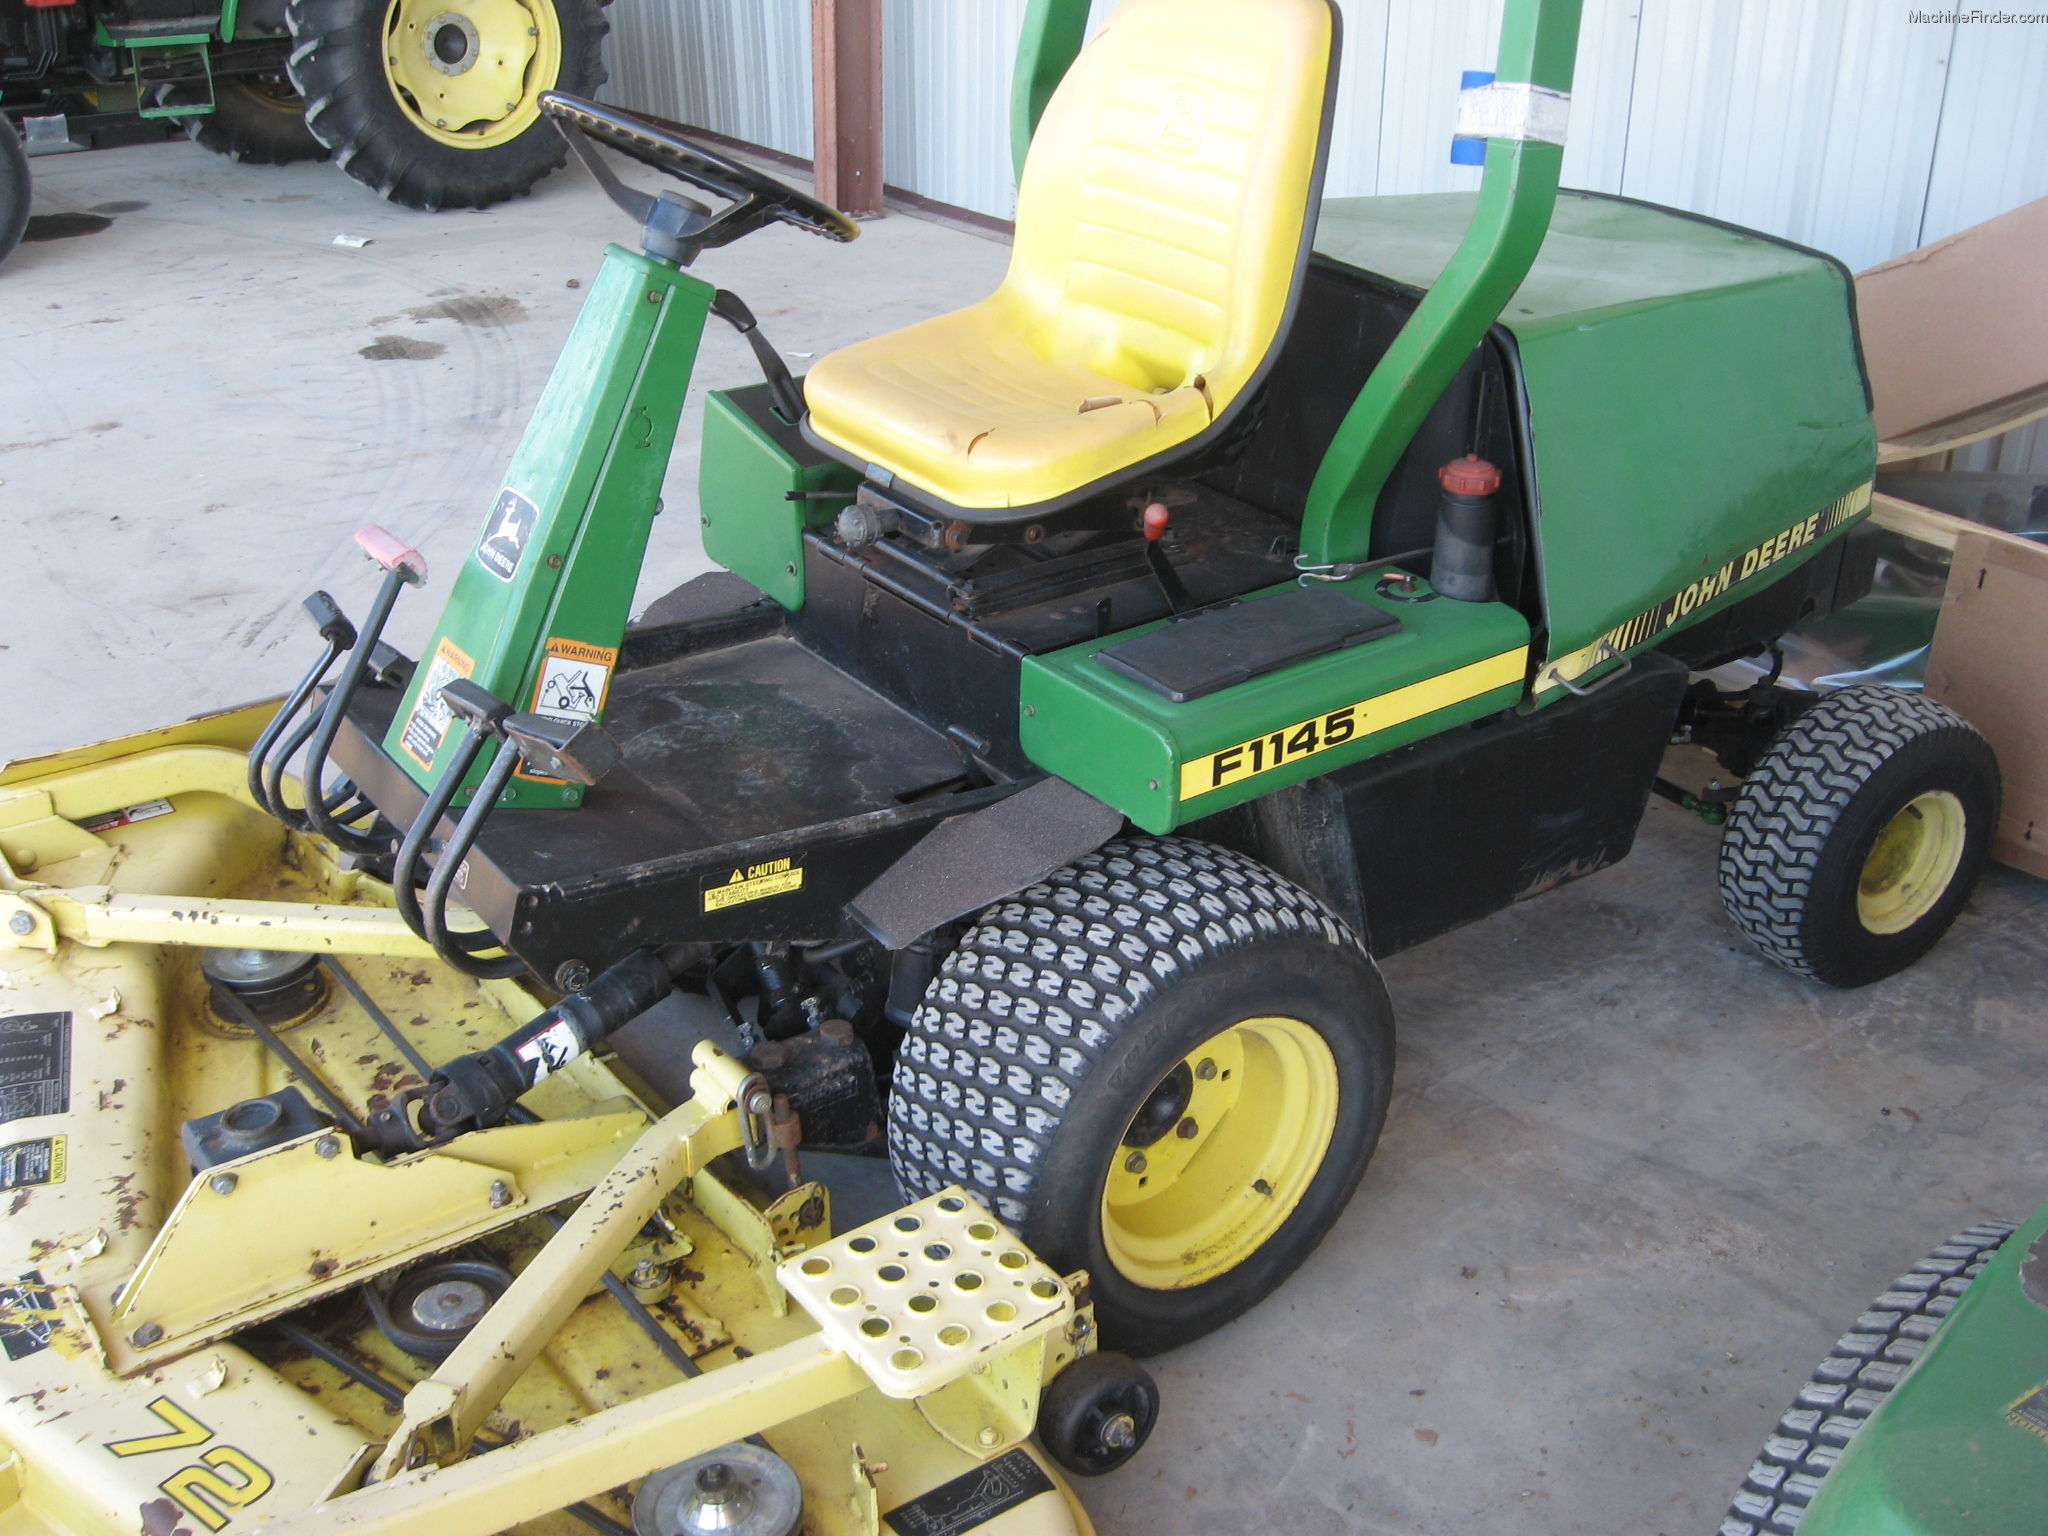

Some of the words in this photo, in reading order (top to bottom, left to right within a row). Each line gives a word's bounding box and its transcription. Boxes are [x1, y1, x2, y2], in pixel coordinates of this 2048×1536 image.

[480, 541, 497, 560] JOHN
[494, 551, 515, 574] DEERE
[1666, 561, 1735, 626] JOHN
[1740, 511, 1820, 581] DEERE
[561, 643, 612, 662] WARNING
[1212, 707, 1355, 787] F1145
[748, 857, 790, 879] CAUTION
[54, 1147, 65, 1180] CAUTION
[102, 1394, 276, 1534] 72
